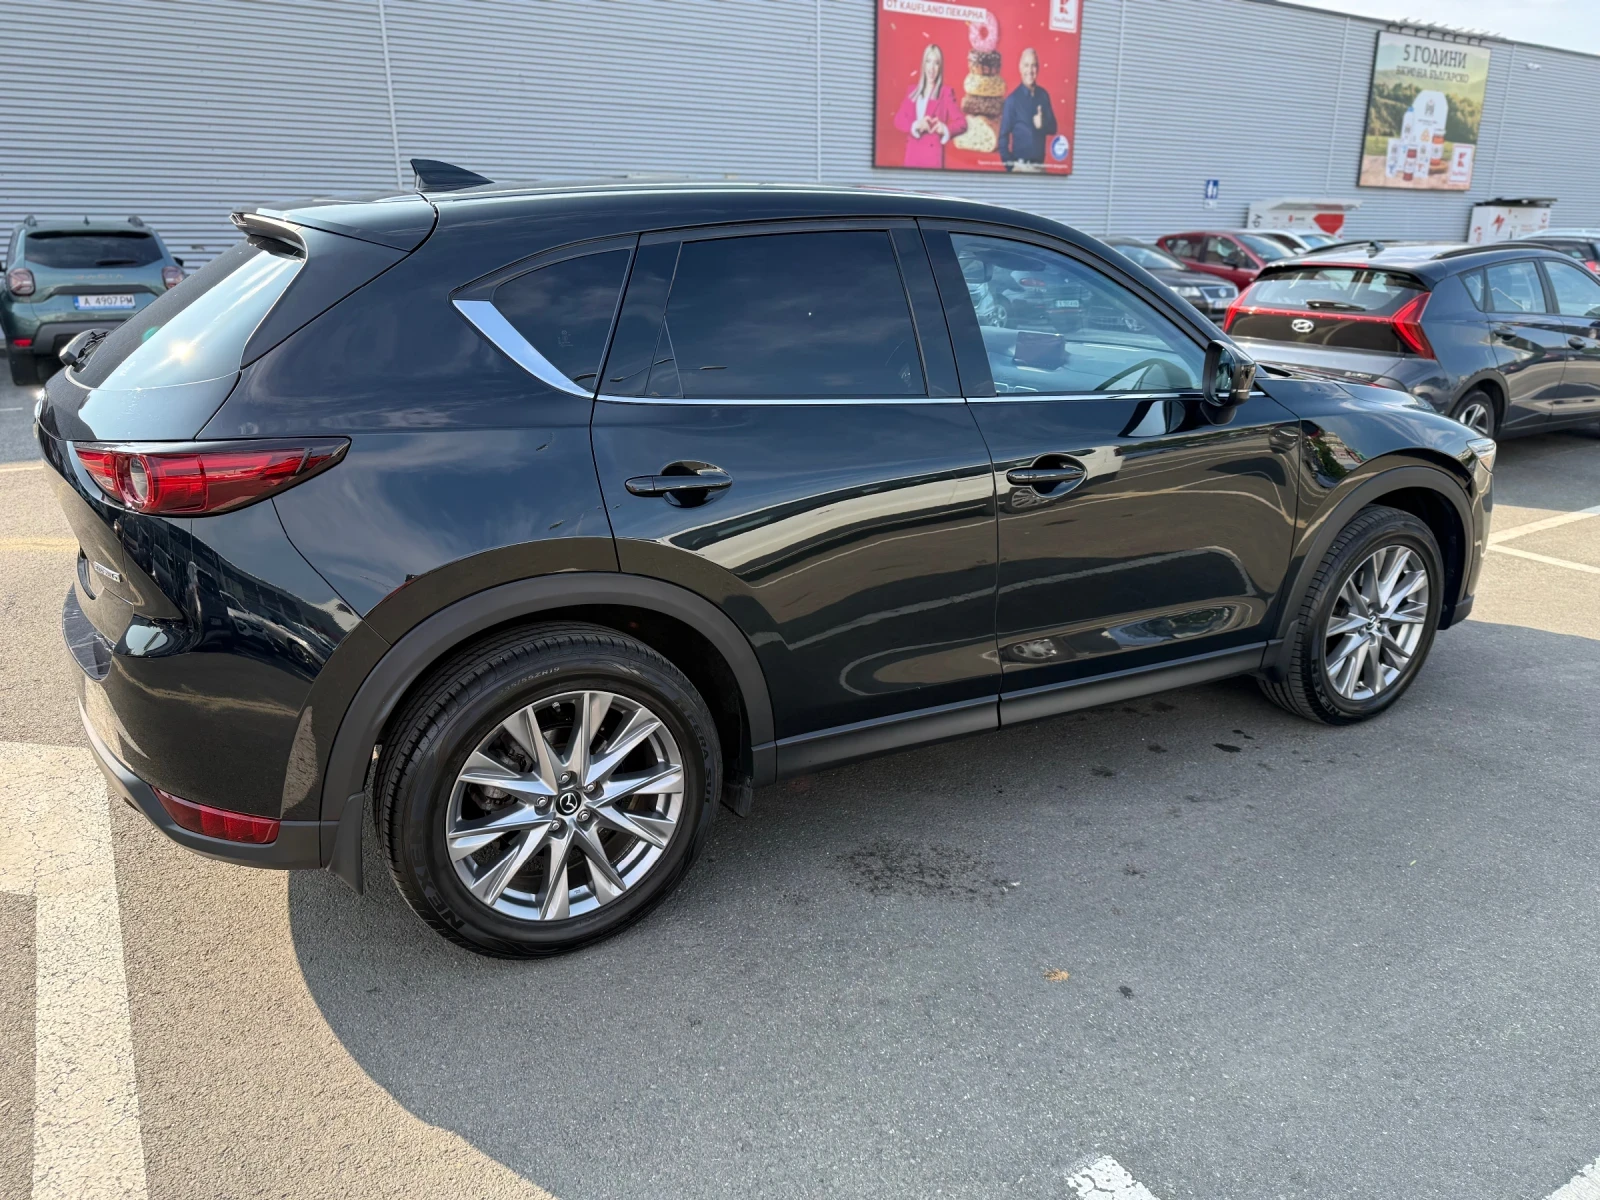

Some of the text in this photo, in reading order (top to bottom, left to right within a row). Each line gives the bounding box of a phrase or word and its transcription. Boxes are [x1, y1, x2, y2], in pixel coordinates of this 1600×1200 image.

[886, 0, 984, 20] ОТ KAUFLAND ПЕКАРНА
[1402, 43, 1468, 69] 5 ГОДИНИ
[1429, 69, 1470, 83] БЪЛГАРСКО
[95, 296, 118, 305] 4907
[407, 819, 465, 930] NEXEN
